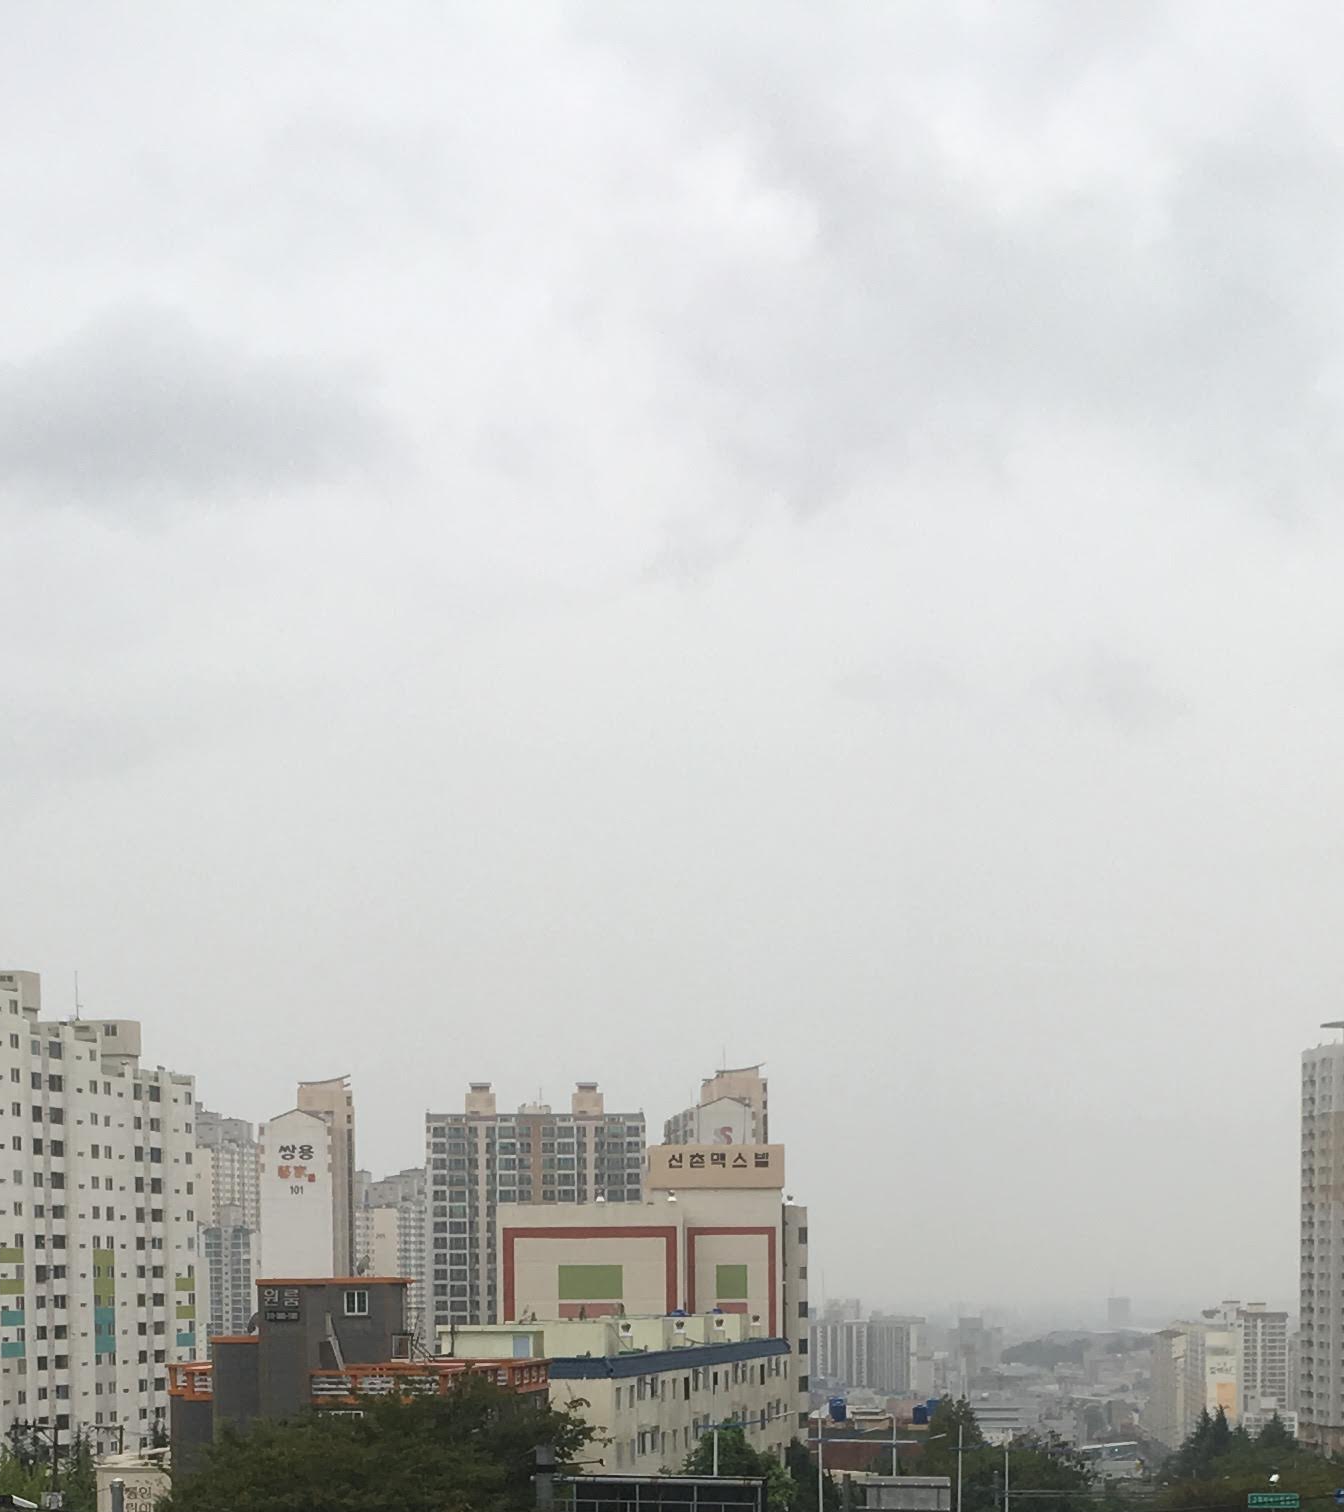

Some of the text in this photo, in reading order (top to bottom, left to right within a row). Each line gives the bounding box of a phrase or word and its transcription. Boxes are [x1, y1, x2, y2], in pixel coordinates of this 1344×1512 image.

[278, 1144, 314, 1161] 쌍용
[667, 1152, 769, 1170] 신촌맥스빌
[289, 1185, 304, 1195] 101
[264, 1288, 300, 1308] 원룸
